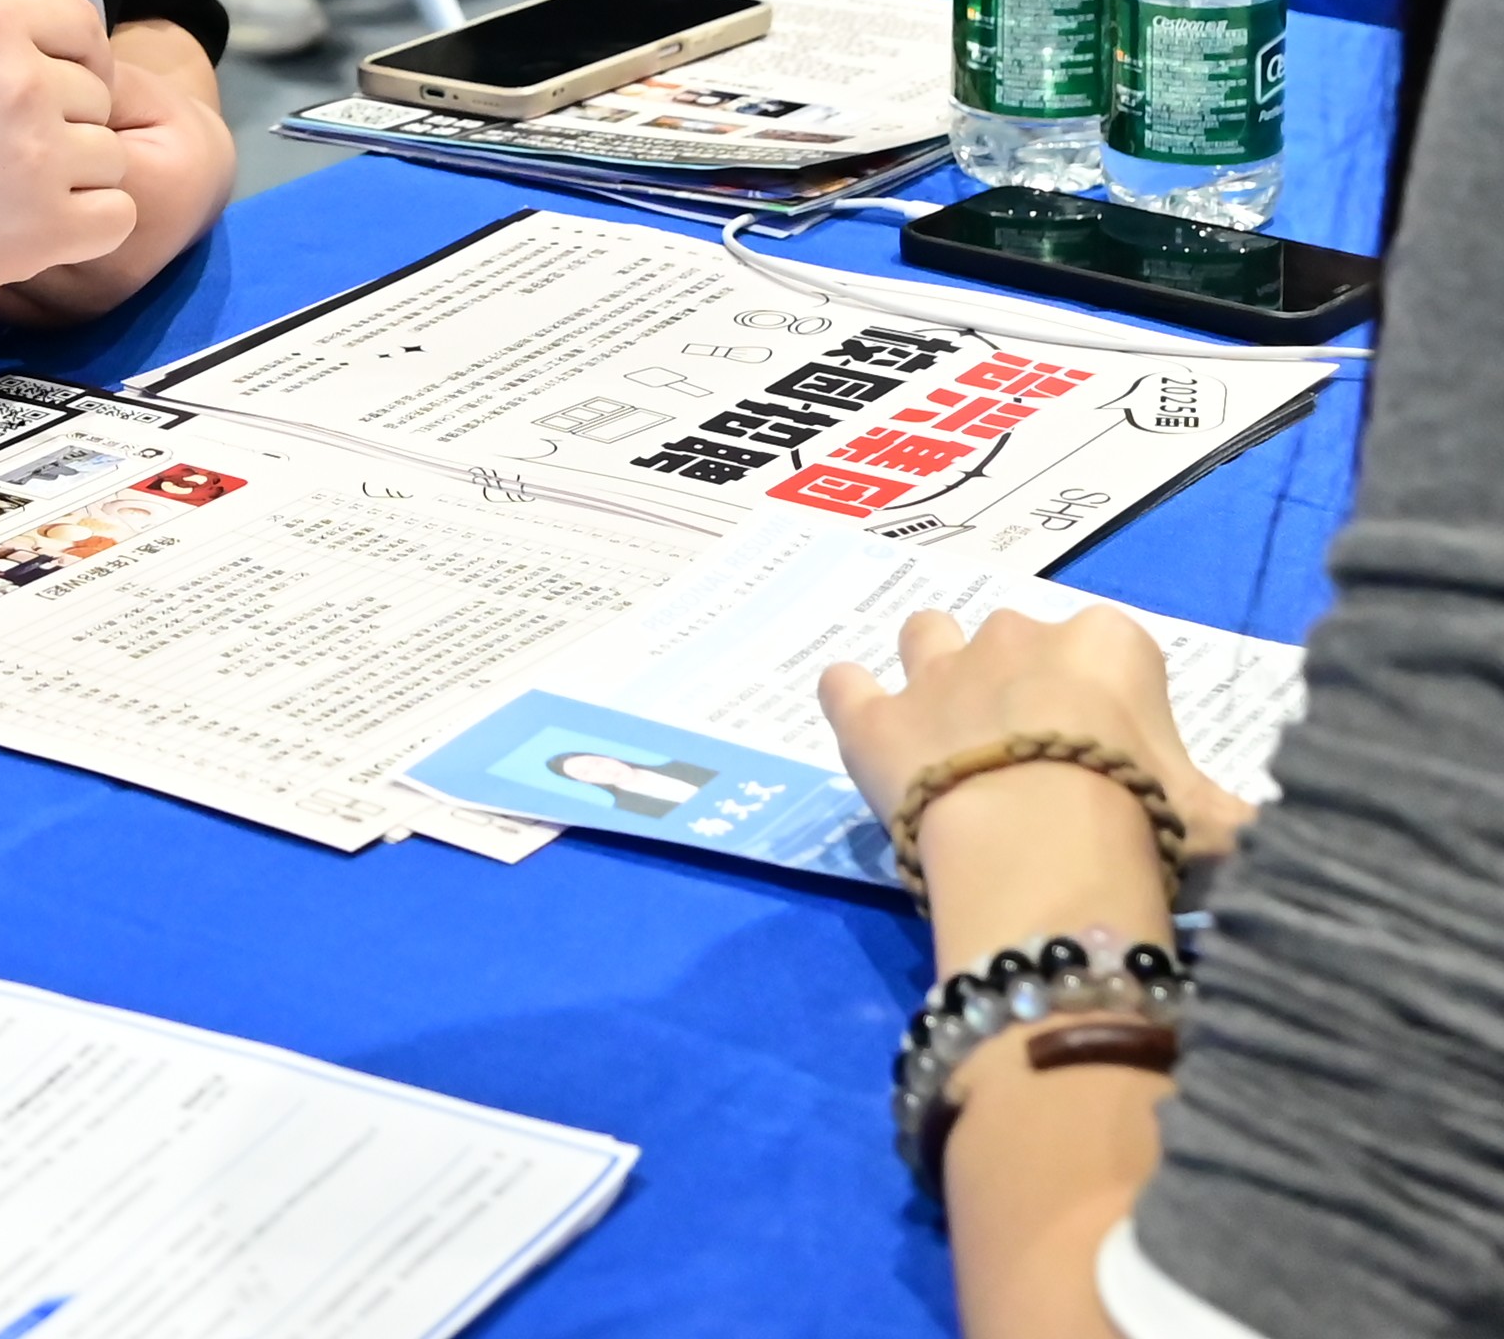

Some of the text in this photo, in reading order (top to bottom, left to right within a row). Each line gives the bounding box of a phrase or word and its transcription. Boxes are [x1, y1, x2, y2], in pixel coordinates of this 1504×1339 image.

[633, 328, 957, 484] 校园招聘
[768, 354, 1089, 517] 洽兴集团
[1155, 377, 1197, 427] 2025届
[1031, 489, 1110, 530] SHP
